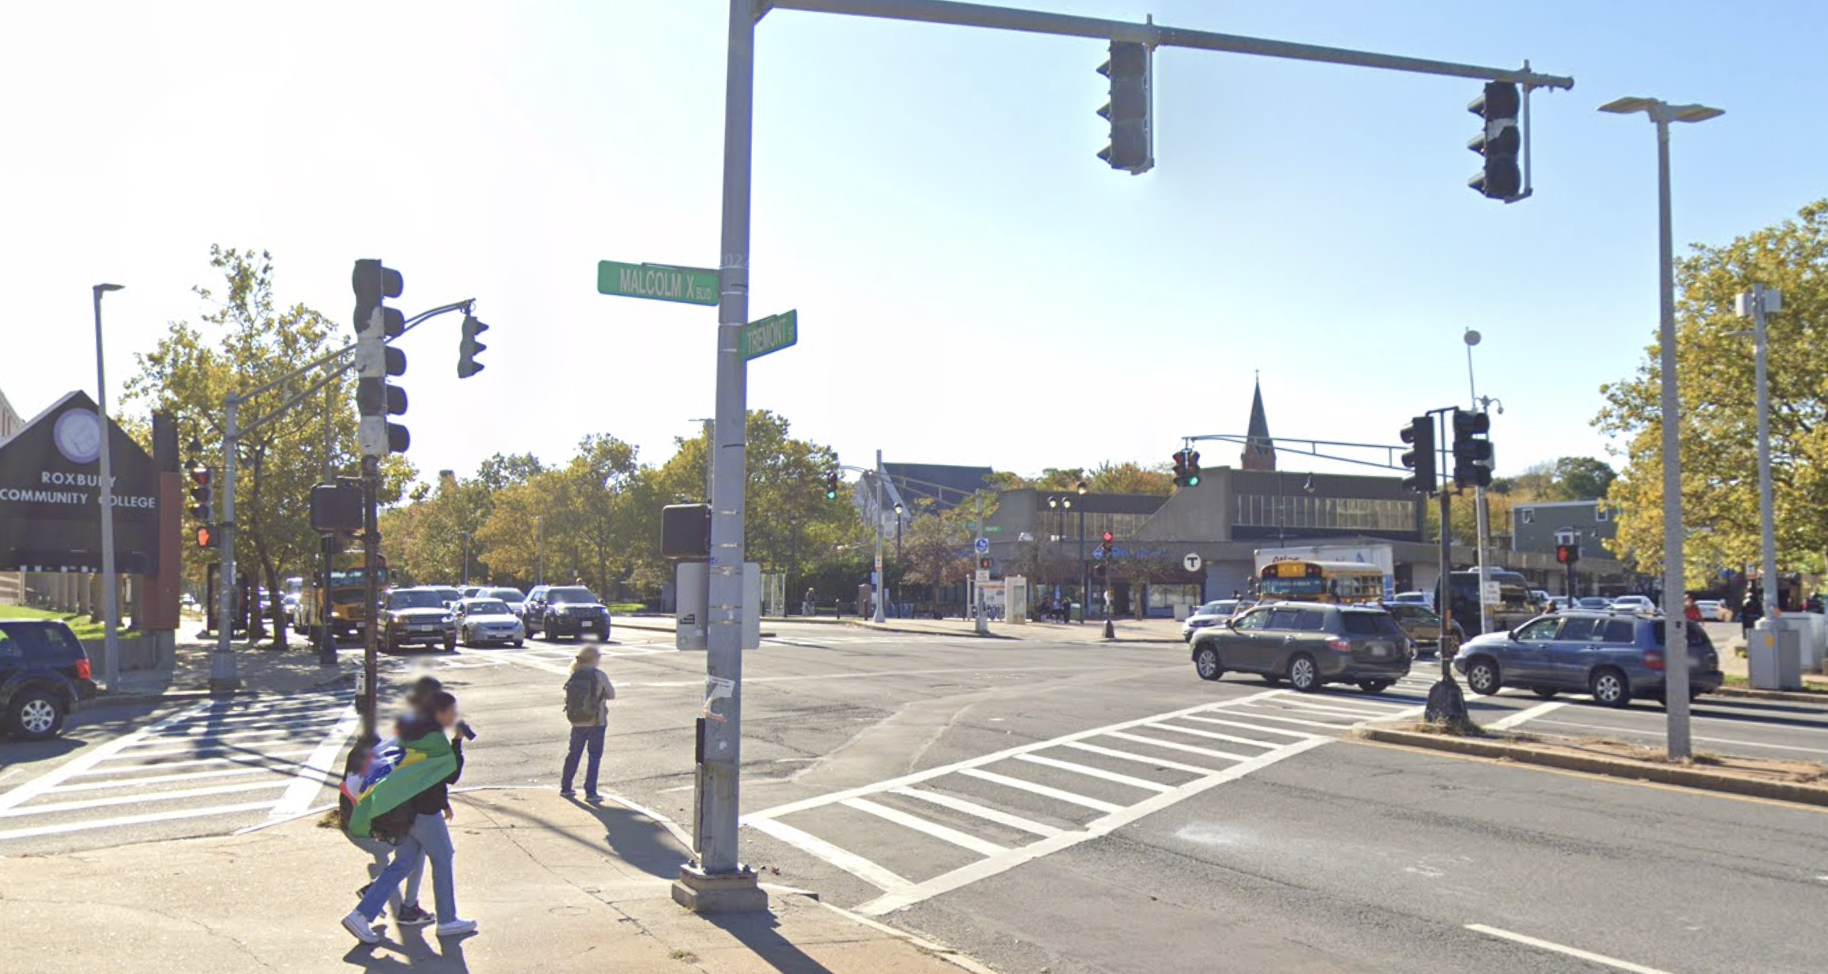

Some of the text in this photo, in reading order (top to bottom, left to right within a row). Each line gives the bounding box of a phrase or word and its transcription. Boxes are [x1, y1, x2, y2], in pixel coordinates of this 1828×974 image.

[620, 268, 711, 300] MALCOLM X BLVD
[747, 318, 787, 355] TREMONT
[0, 488, 88, 504] COMMUNITY
[1187, 556, 1198, 568] T
